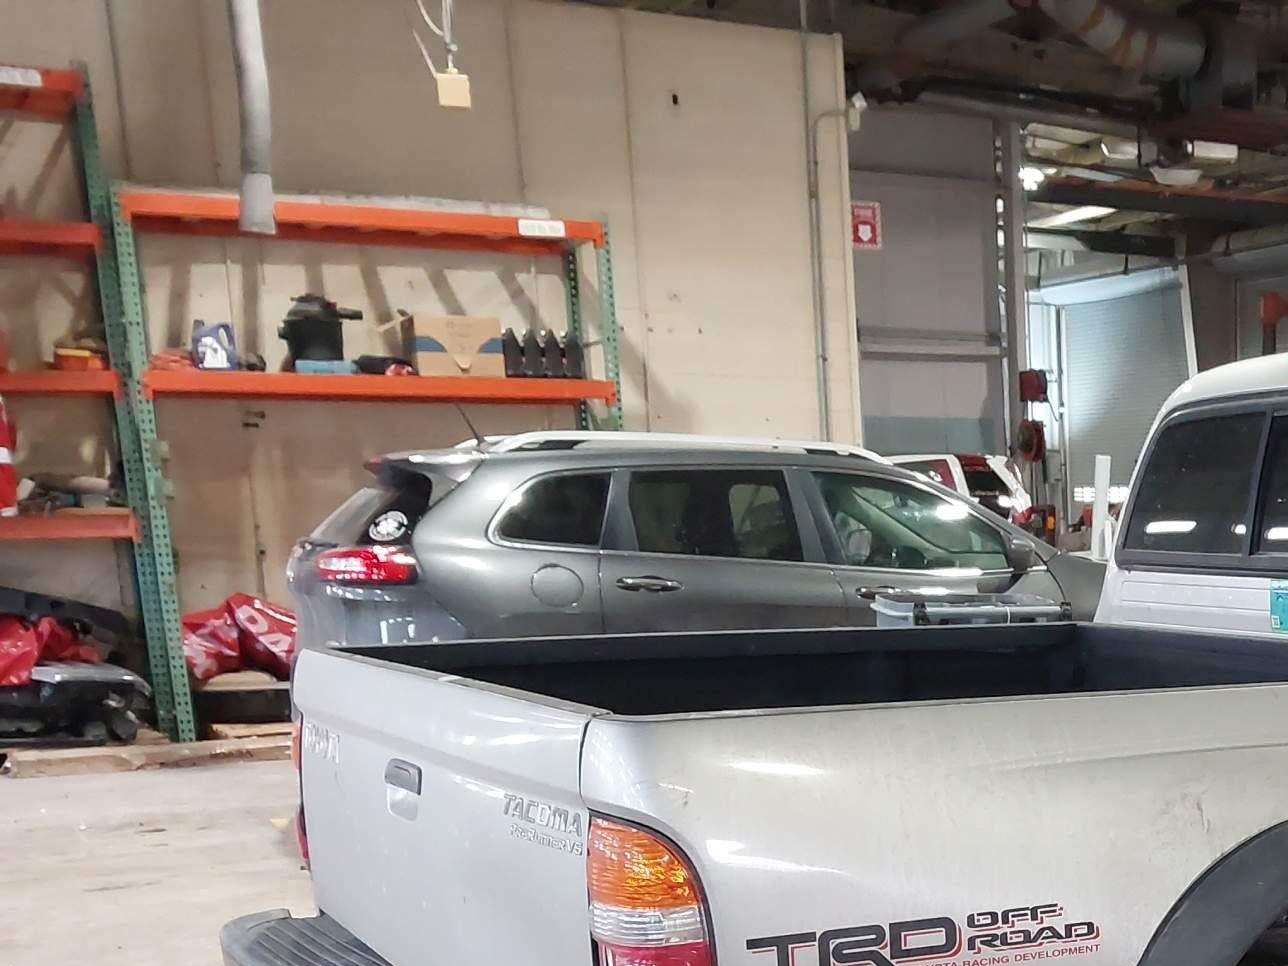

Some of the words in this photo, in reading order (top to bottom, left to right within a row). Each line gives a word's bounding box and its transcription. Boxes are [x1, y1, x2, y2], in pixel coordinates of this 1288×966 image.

[503, 793, 582, 838] TACOMA
[966, 903, 1064, 932] OFF
[967, 921, 1100, 955] ROAD
[1014, 943, 1101, 963] DEVELOPMENT
